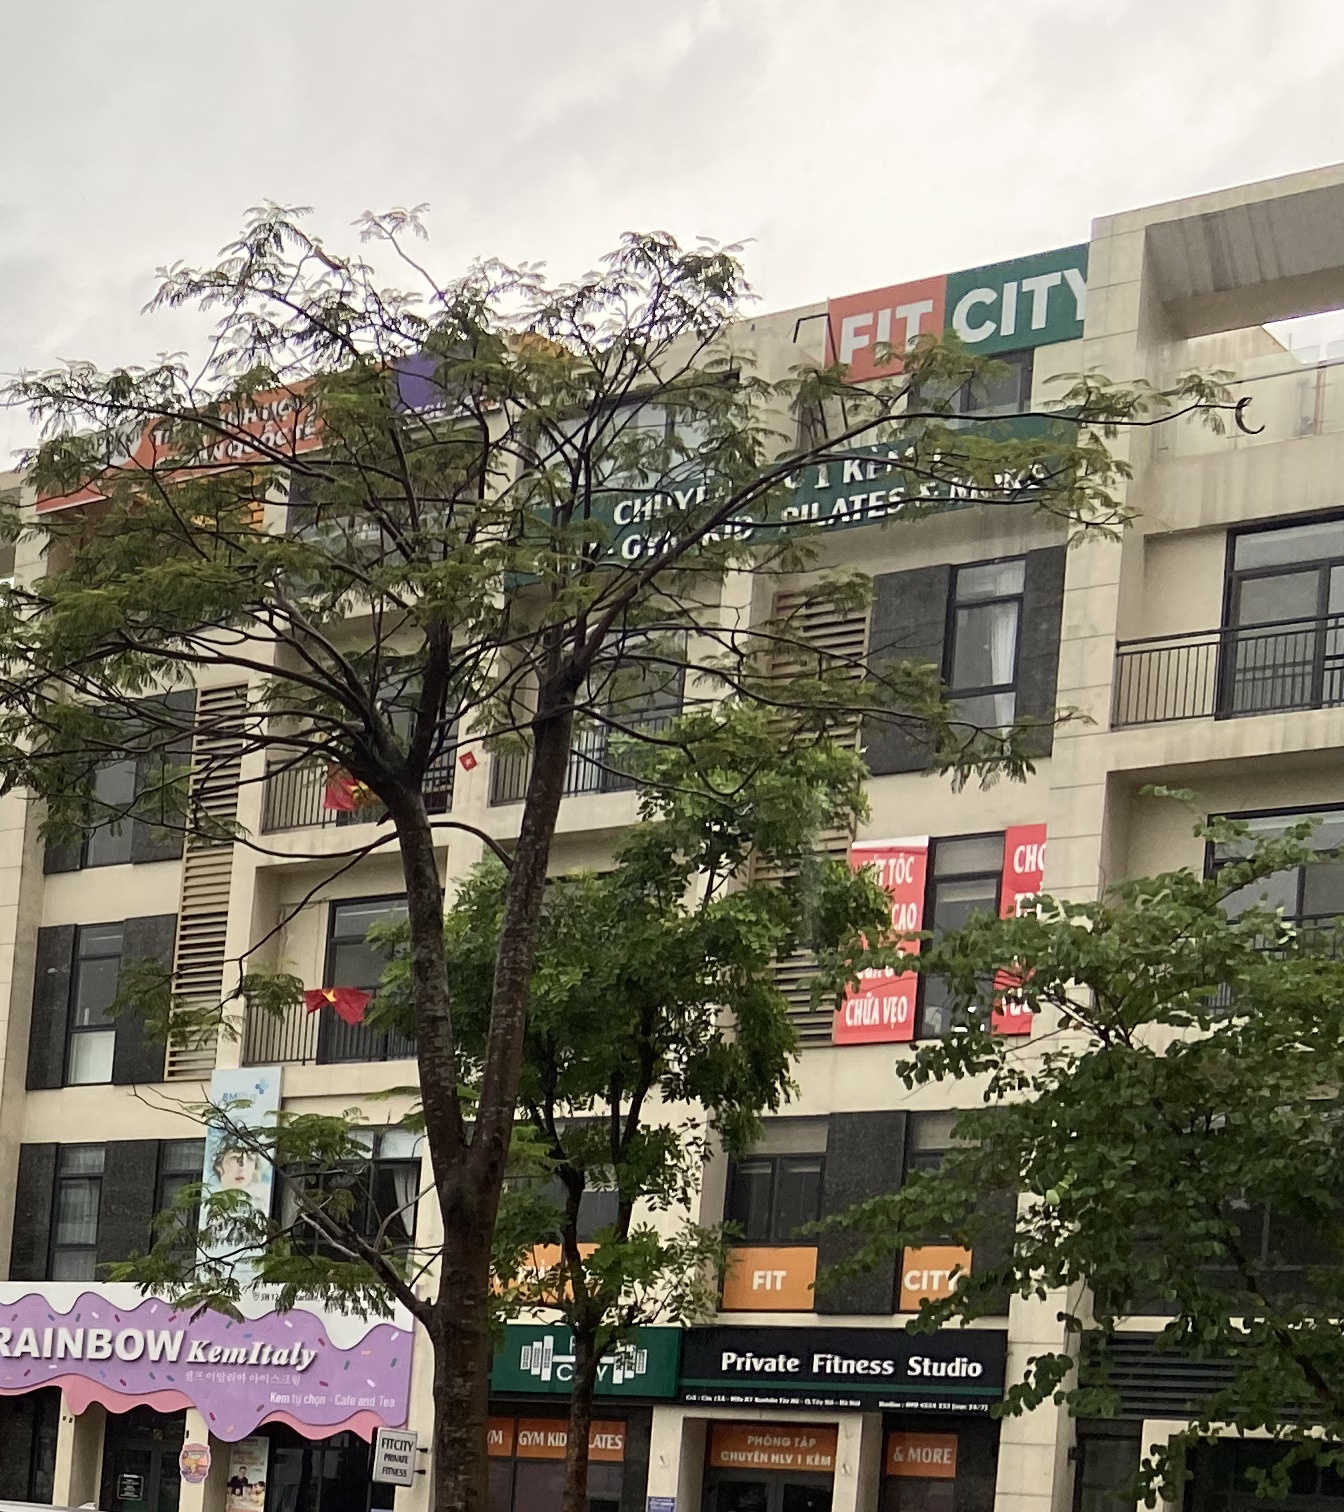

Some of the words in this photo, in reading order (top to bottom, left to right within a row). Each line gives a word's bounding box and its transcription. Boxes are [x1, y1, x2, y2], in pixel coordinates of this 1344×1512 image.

[839, 299, 934, 365] FIT
[752, 1270, 787, 1291] FIT
[904, 1269, 963, 1291] CITY
[557, 1363, 609, 1382] CY
[721, 1352, 801, 1373] Private
[812, 1353, 895, 1376] Fitness
[907, 1355, 983, 1378] Studio
[270, 1392, 291, 1404] Kem
[303, 1393, 327, 1408] chọn
[335, 1393, 356, 1407] Cafe
[357, 1394, 376, 1408] and
[378, 1395, 396, 1409] Tea
[519, 1430, 545, 1447] GYM
[771, 1452, 793, 1466] HLV
[894, 1447, 904, 1463] &
[907, 1446, 953, 1465] MORE
